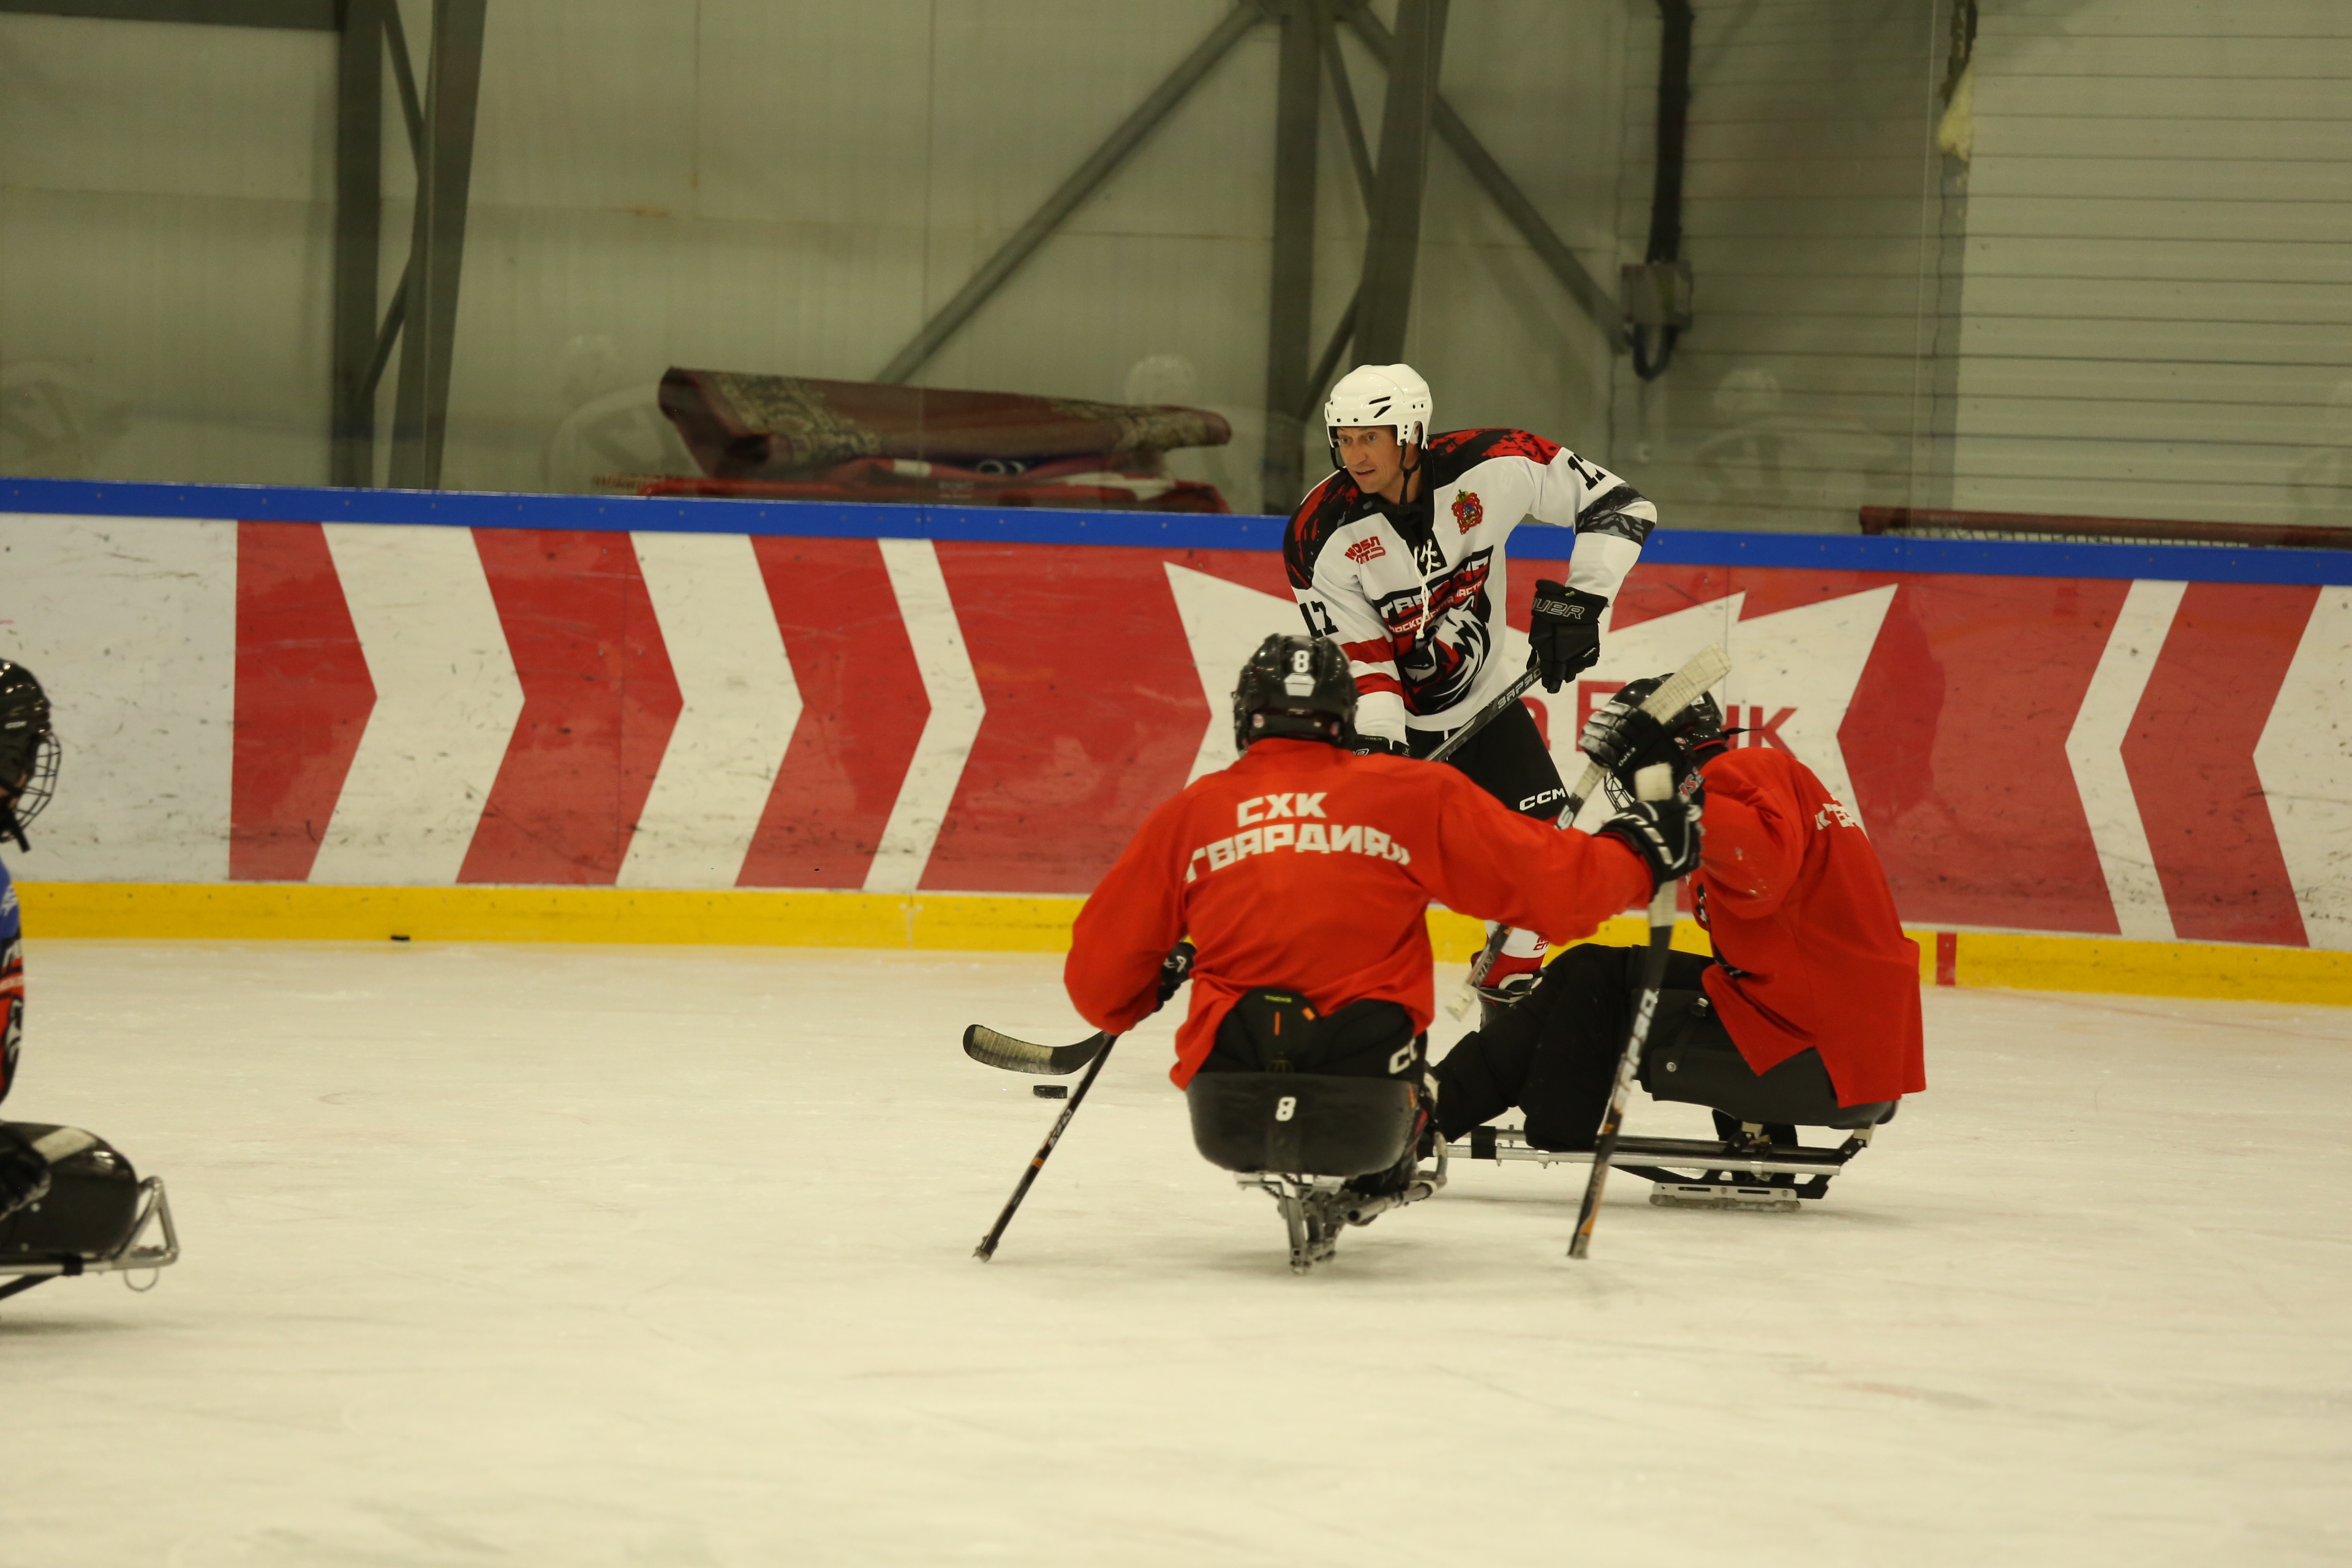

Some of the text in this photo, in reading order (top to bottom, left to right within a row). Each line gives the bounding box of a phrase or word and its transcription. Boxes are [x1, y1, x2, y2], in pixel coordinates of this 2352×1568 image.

[1299, 600, 1340, 638] 17
[1532, 598, 1585, 619] UER
[1293, 650, 1310, 673] 8
[1237, 793, 1328, 827] СХК
[1519, 788, 1566, 811] CCM
[1389, 1037, 1418, 1074] CC
[1276, 1096, 1297, 1121] 8
